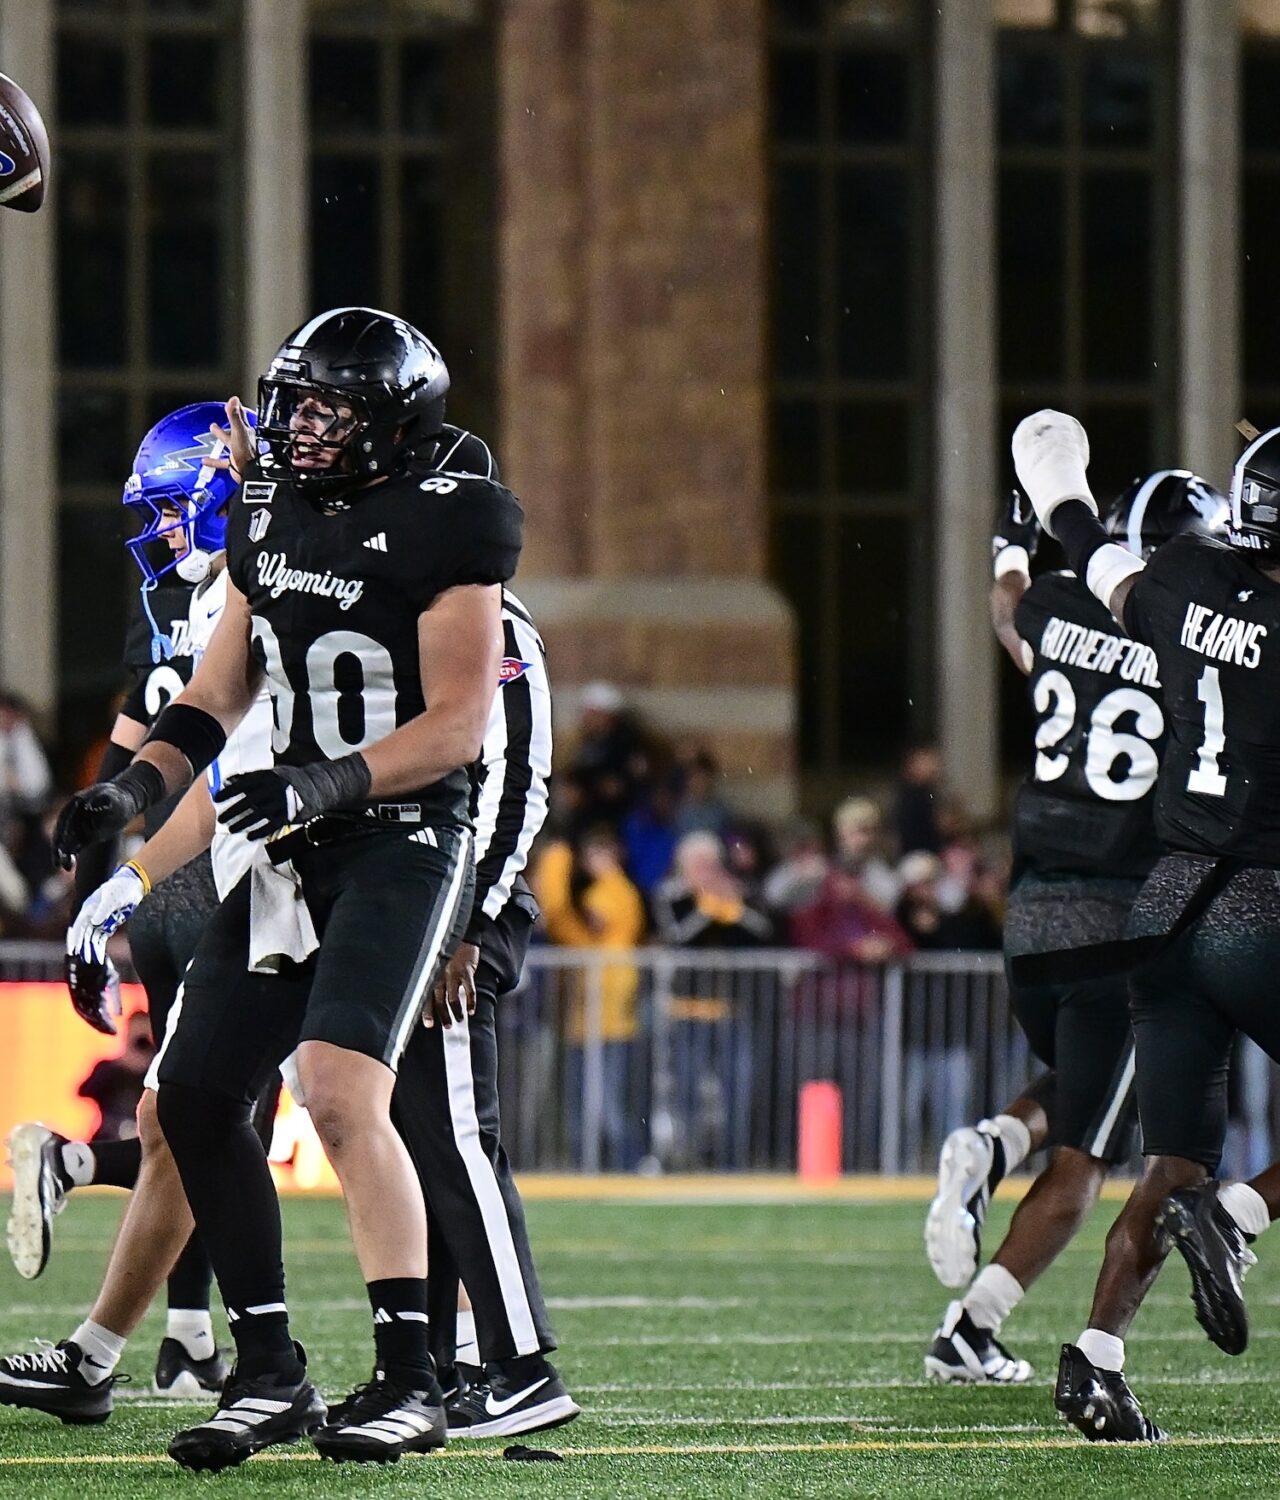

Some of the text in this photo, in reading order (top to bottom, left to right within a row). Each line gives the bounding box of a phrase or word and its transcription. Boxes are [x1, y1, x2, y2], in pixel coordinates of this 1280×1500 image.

[256, 550, 364, 611] Wyoming
[1180, 601, 1268, 669] HEARNS
[1034, 669, 1165, 801] 26
[1186, 664, 1228, 797] 1
